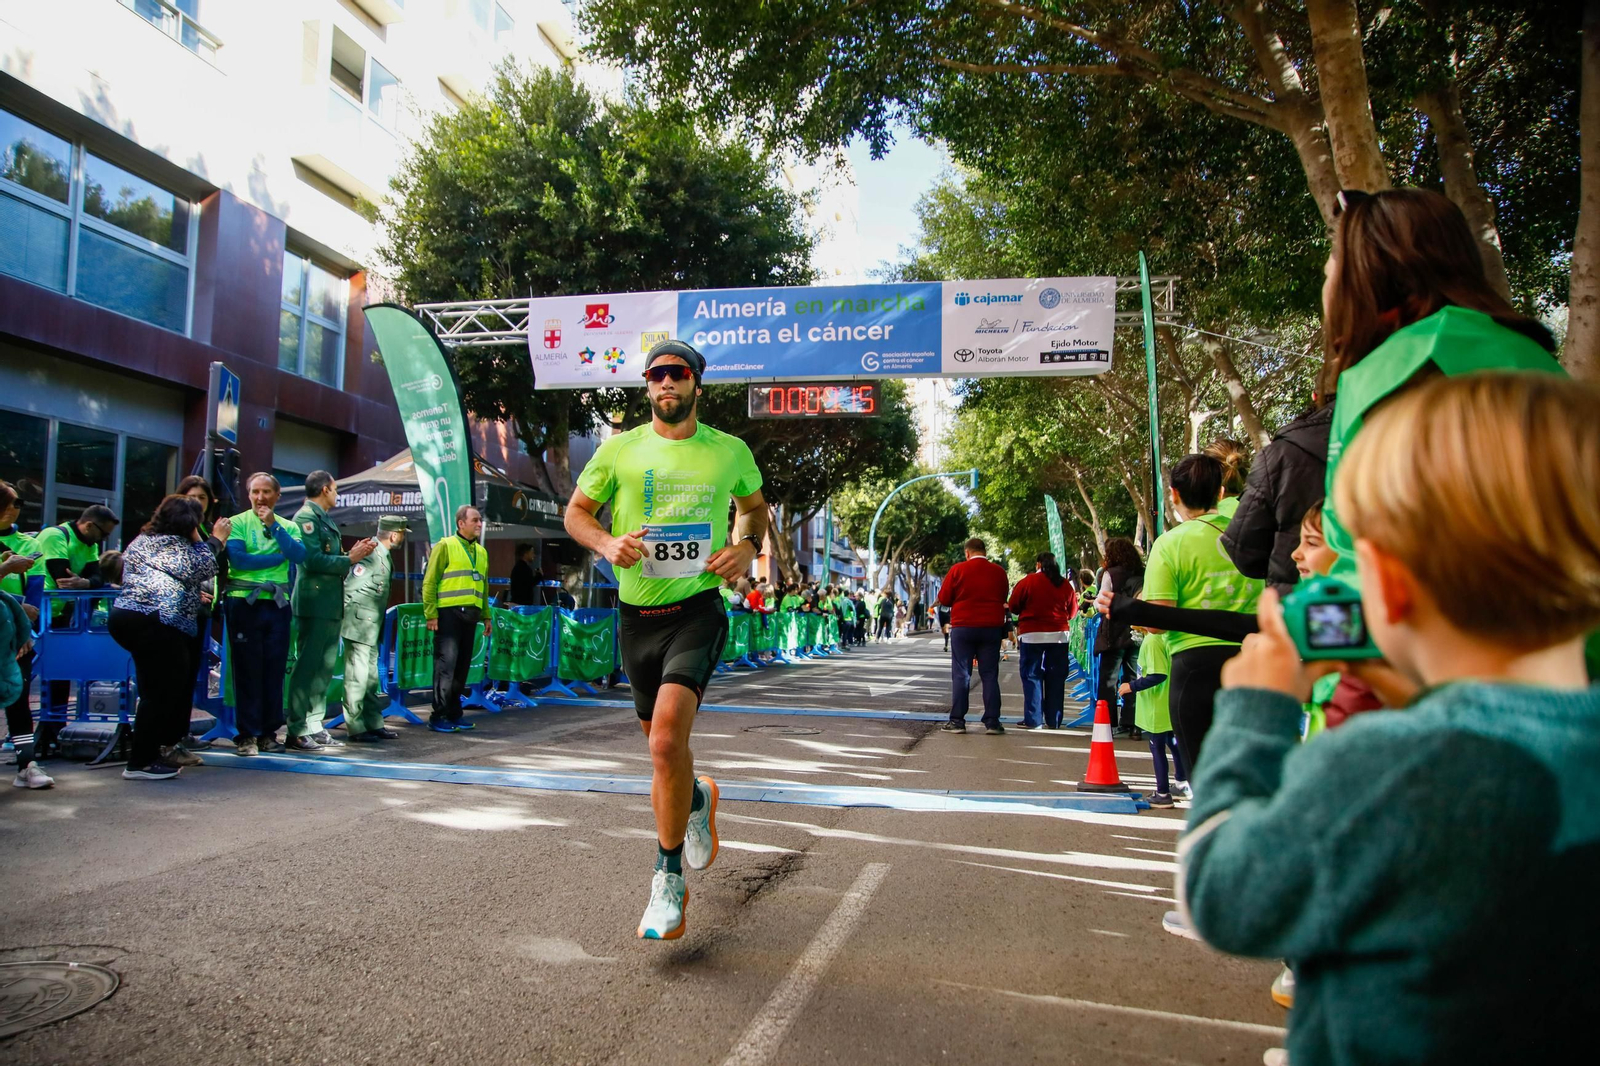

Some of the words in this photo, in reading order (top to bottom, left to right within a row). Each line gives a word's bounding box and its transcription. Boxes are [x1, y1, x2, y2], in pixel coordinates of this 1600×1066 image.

[694, 297, 786, 319] Almería
[794, 300, 824, 315] en
[832, 293, 926, 314] marcha
[974, 292, 1024, 306] cajamar
[693, 325, 770, 346] contra
[778, 323, 801, 343] el
[808, 321, 894, 342] cáncer
[1051, 340, 1071, 349] Ejido
[1073, 339, 1099, 347] Motor
[535, 352, 568, 361] ALMERÍA
[705, 363, 764, 372] osContraElCáncer
[643, 469, 654, 518] ALMERÍA
[656, 482, 670, 491] En
[673, 482, 716, 493] marcha
[335, 490, 424, 507] cruzandolame
[656, 492, 699, 503] contra
[702, 493, 713, 504] el
[655, 503, 711, 517] cáncer
[654, 541, 699, 561] 838
